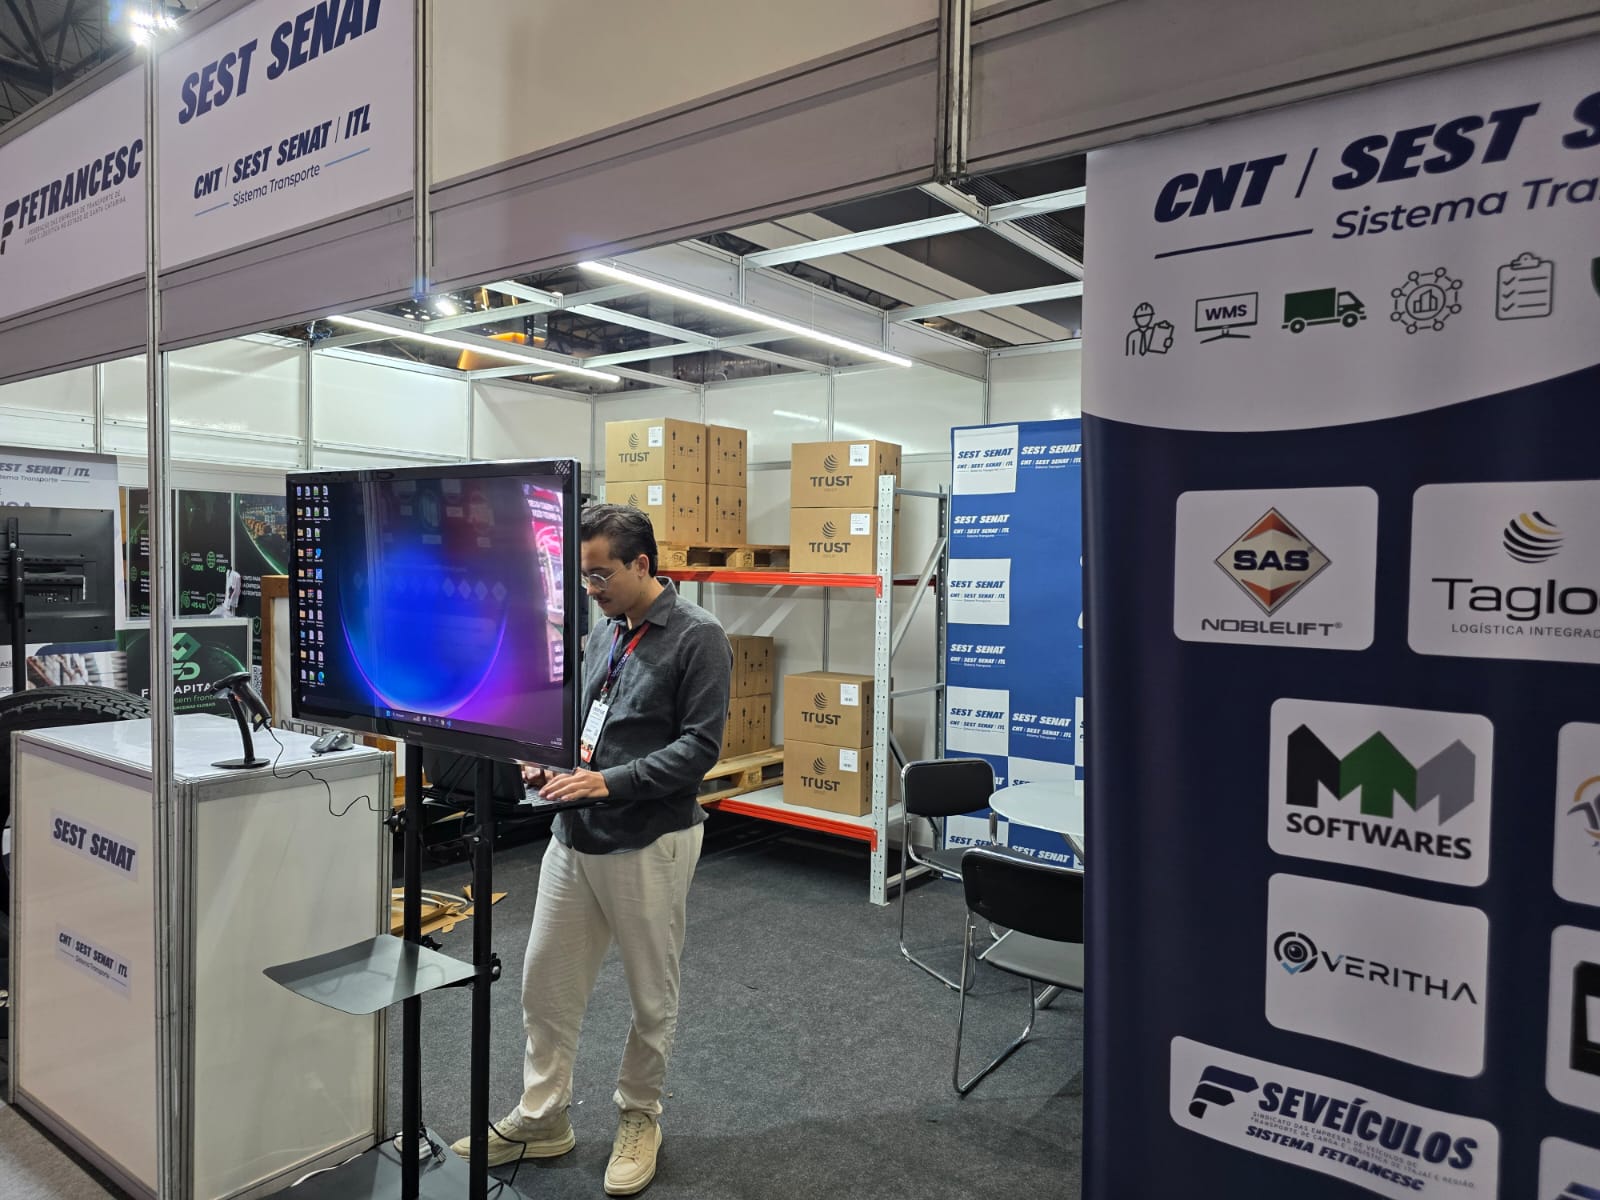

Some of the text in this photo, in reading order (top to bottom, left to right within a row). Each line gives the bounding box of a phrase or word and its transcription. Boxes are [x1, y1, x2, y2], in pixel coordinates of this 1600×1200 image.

[178, 0, 382, 125] SEST SENAT
[194, 167, 223, 199] CNT
[232, 145, 272, 184] SEST
[276, 120, 333, 166] SENAT
[344, 104, 371, 140] ITL
[1154, 153, 1287, 223] CNT
[1331, 102, 1541, 191] SEST
[18, 138, 143, 230] FETRANCESC
[232, 164, 321, 207] Sistema Transporte
[1332, 177, 1600, 240] Sistema Tra
[1204, 304, 1248, 322] WMS
[958, 447, 1014, 459] SEST SENAT
[1021, 443, 1082, 455] SEST SENAT
[25, 464, 65, 475] SENAT
[74, 467, 90, 477] ITL
[953, 514, 1010, 524] SEST SENAT
[1233, 549, 1310, 571] SAS
[950, 580, 1005, 589] SEST SENAT
[1431, 577, 1600, 622] Taglo
[1451, 622, 1524, 636] LOGÍSTICA
[950, 643, 1006, 655] SEST SENAT
[173, 682, 213, 695] APITA
[950, 707, 1005, 719] SEST SENAT
[1012, 712, 1038, 723] SEST
[1039, 715, 1072, 727] SENAT
[53, 817, 136, 872] SEST SENAT
[949, 835, 972, 846] SEST
[1286, 812, 1472, 861] SOFTWARES
[1012, 845, 1071, 863] SEST SENAT
[59, 932, 128, 978] CNT SEST SENAT ITL
[1320, 950, 1478, 1005] VERITHA
[1258, 1082, 1478, 1170] SEVEÍCULOS
[1294, 1122, 1309, 1132] DAS
[1311, 1127, 1352, 1144] EMPRESAS
[1245, 1125, 1426, 1191] SISTEMA FETRANCESC
